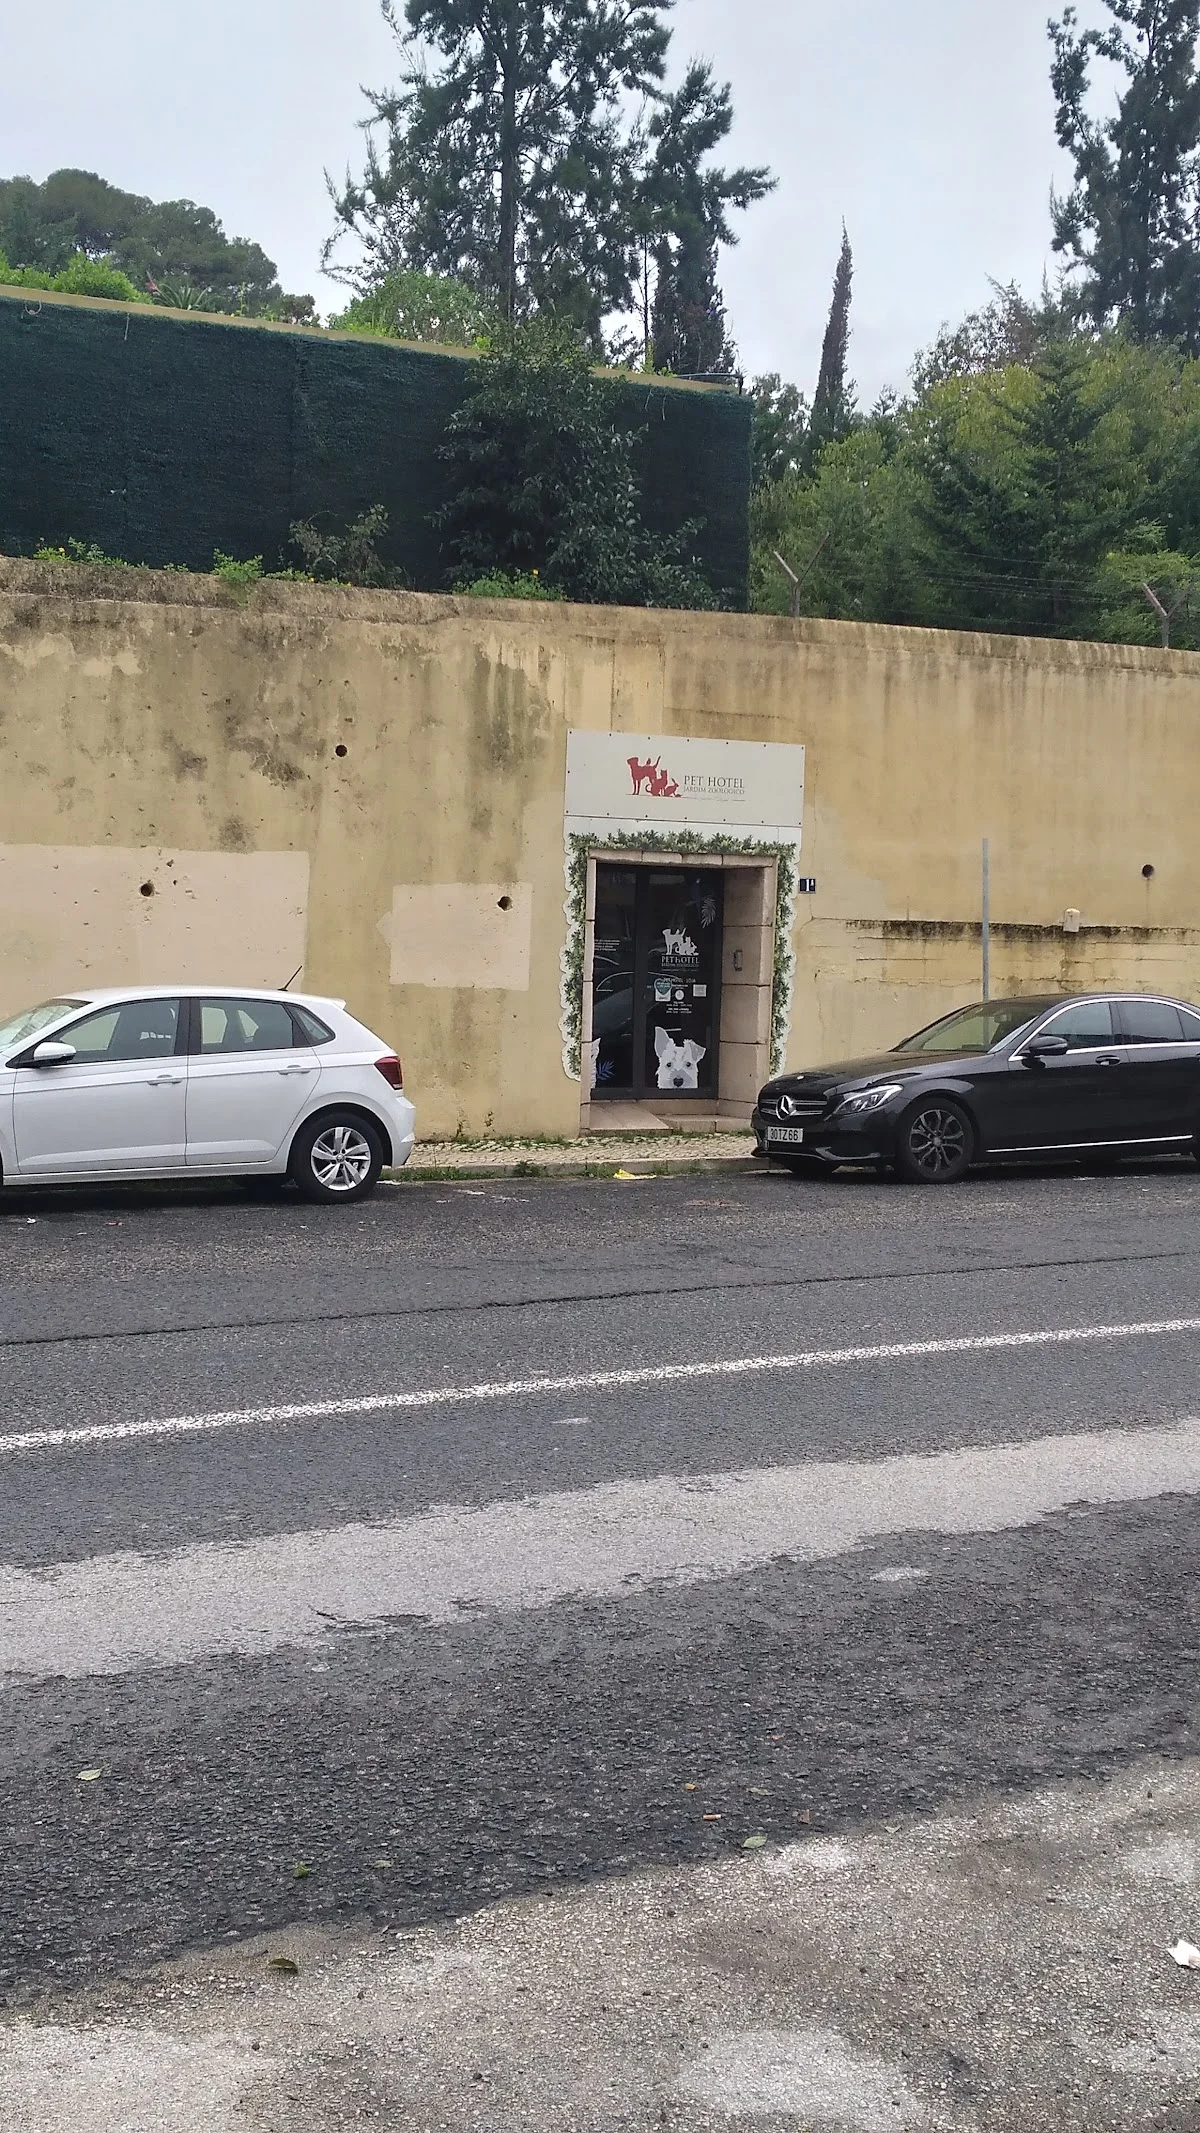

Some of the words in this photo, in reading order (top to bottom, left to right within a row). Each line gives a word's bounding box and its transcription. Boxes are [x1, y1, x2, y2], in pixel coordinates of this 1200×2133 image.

[684, 775, 704, 786] PET
[708, 776, 744, 788] HOTEL
[675, 956, 700, 964] HOTEL
